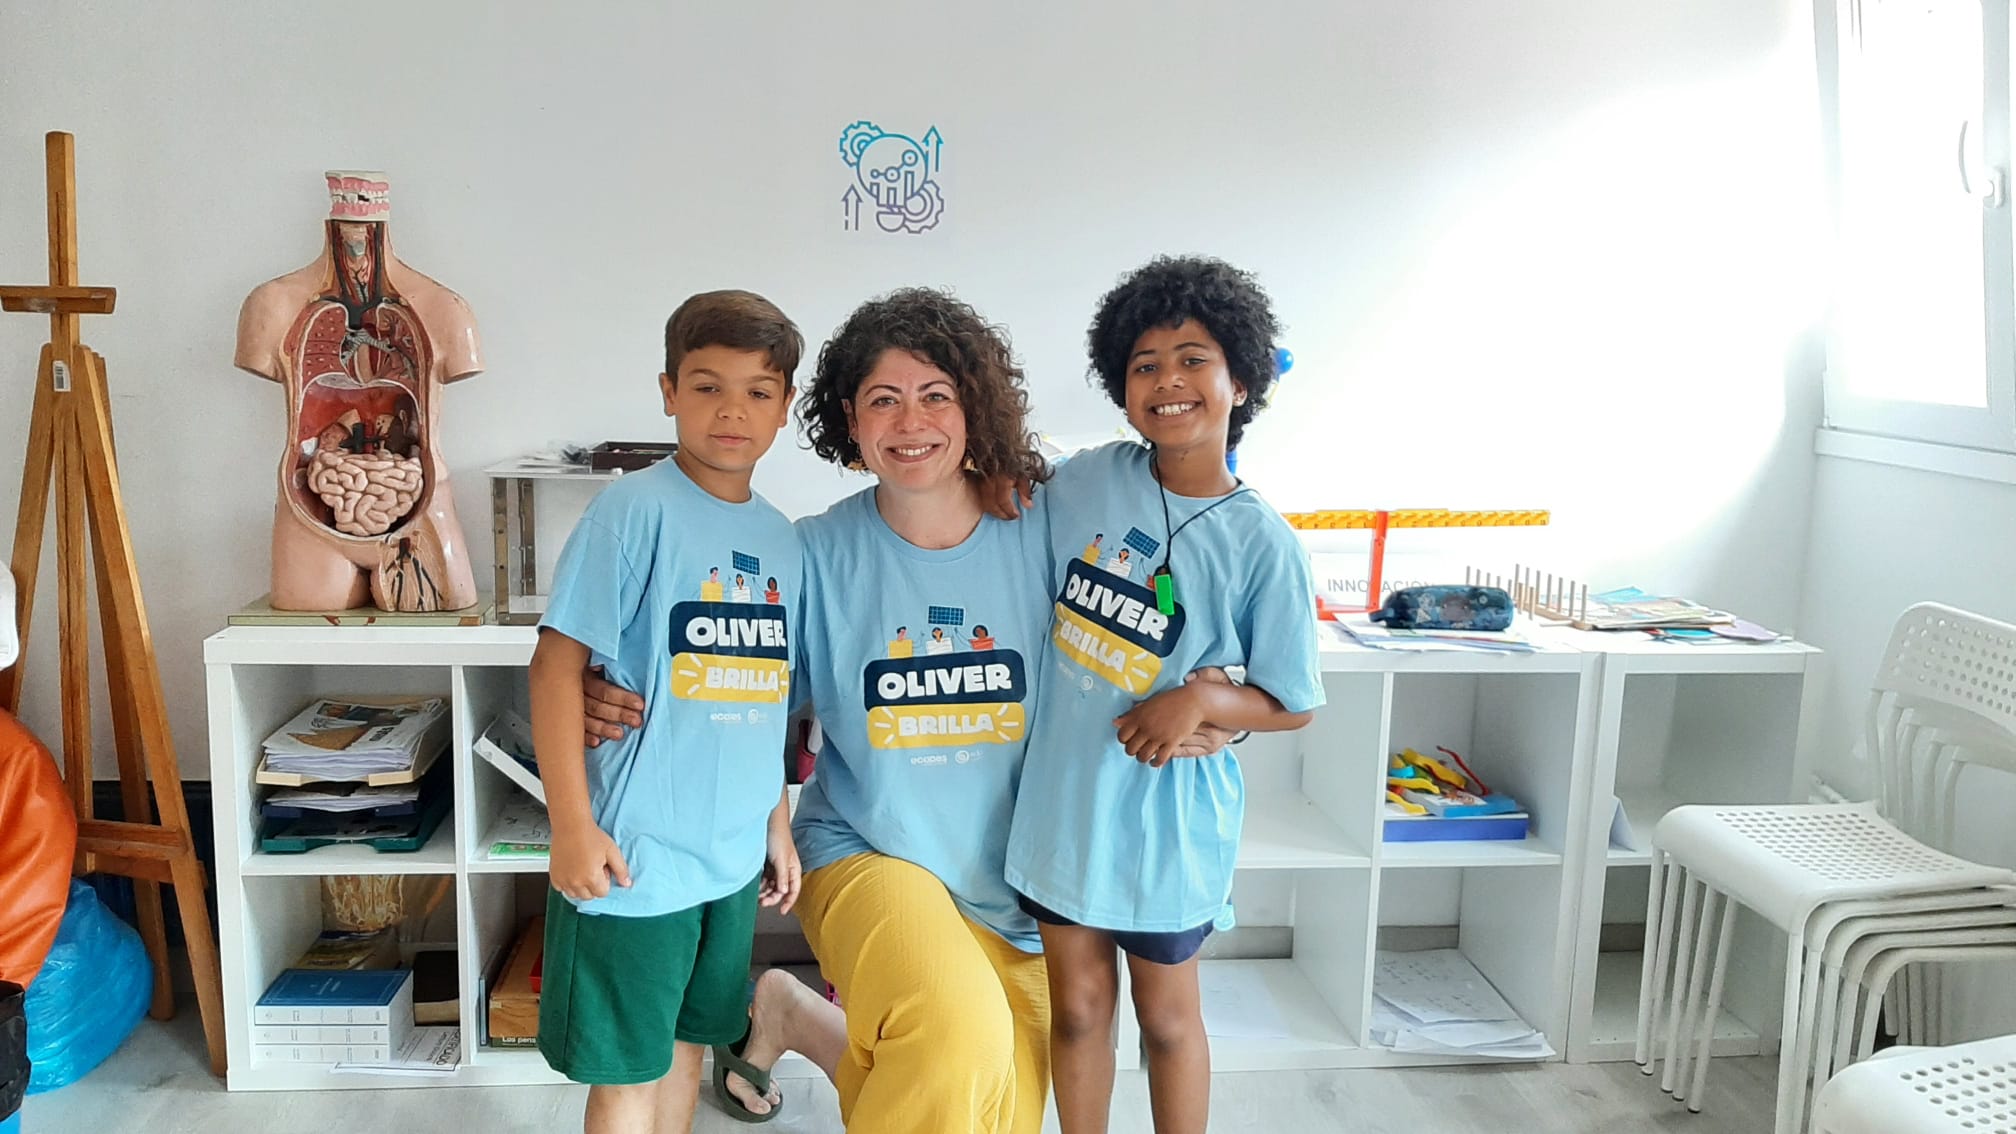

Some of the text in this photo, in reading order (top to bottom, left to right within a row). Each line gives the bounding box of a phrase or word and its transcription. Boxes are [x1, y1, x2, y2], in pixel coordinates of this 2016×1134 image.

[1066, 573, 1168, 640] OLIVER
[686, 616, 787, 646] OLIVER
[1060, 620, 1126, 672] BRILLA
[705, 666, 779, 691] BRILLA
[877, 663, 1012, 700] OLIVER
[898, 713, 994, 736] BRILLA
